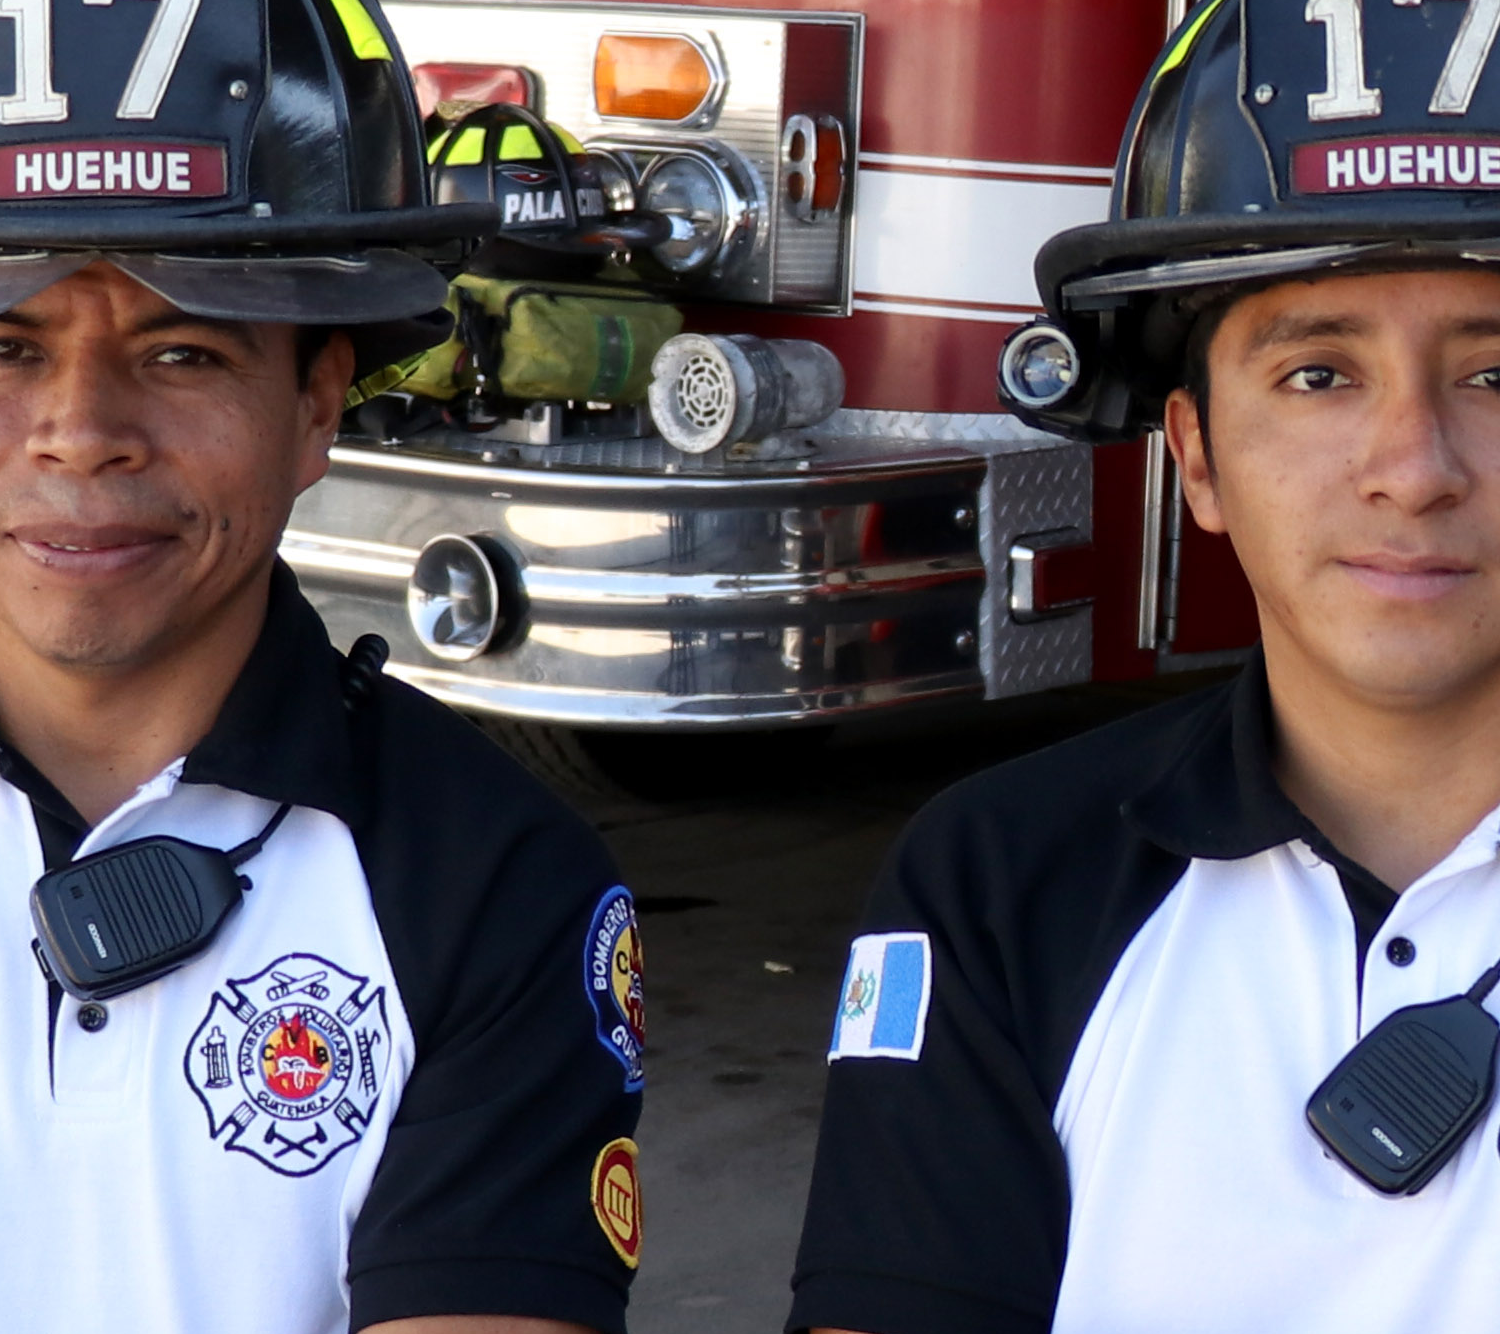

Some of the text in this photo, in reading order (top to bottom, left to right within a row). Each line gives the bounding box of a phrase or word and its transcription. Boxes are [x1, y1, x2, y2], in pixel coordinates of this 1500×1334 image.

[15, 151, 192, 193] HUEHUE
[592, 897, 628, 991] BOMBEROS
[616, 950, 629, 975] C
[241, 1008, 286, 1076] BOMBEROS
[256, 1090, 331, 1118] GUATEMALA
